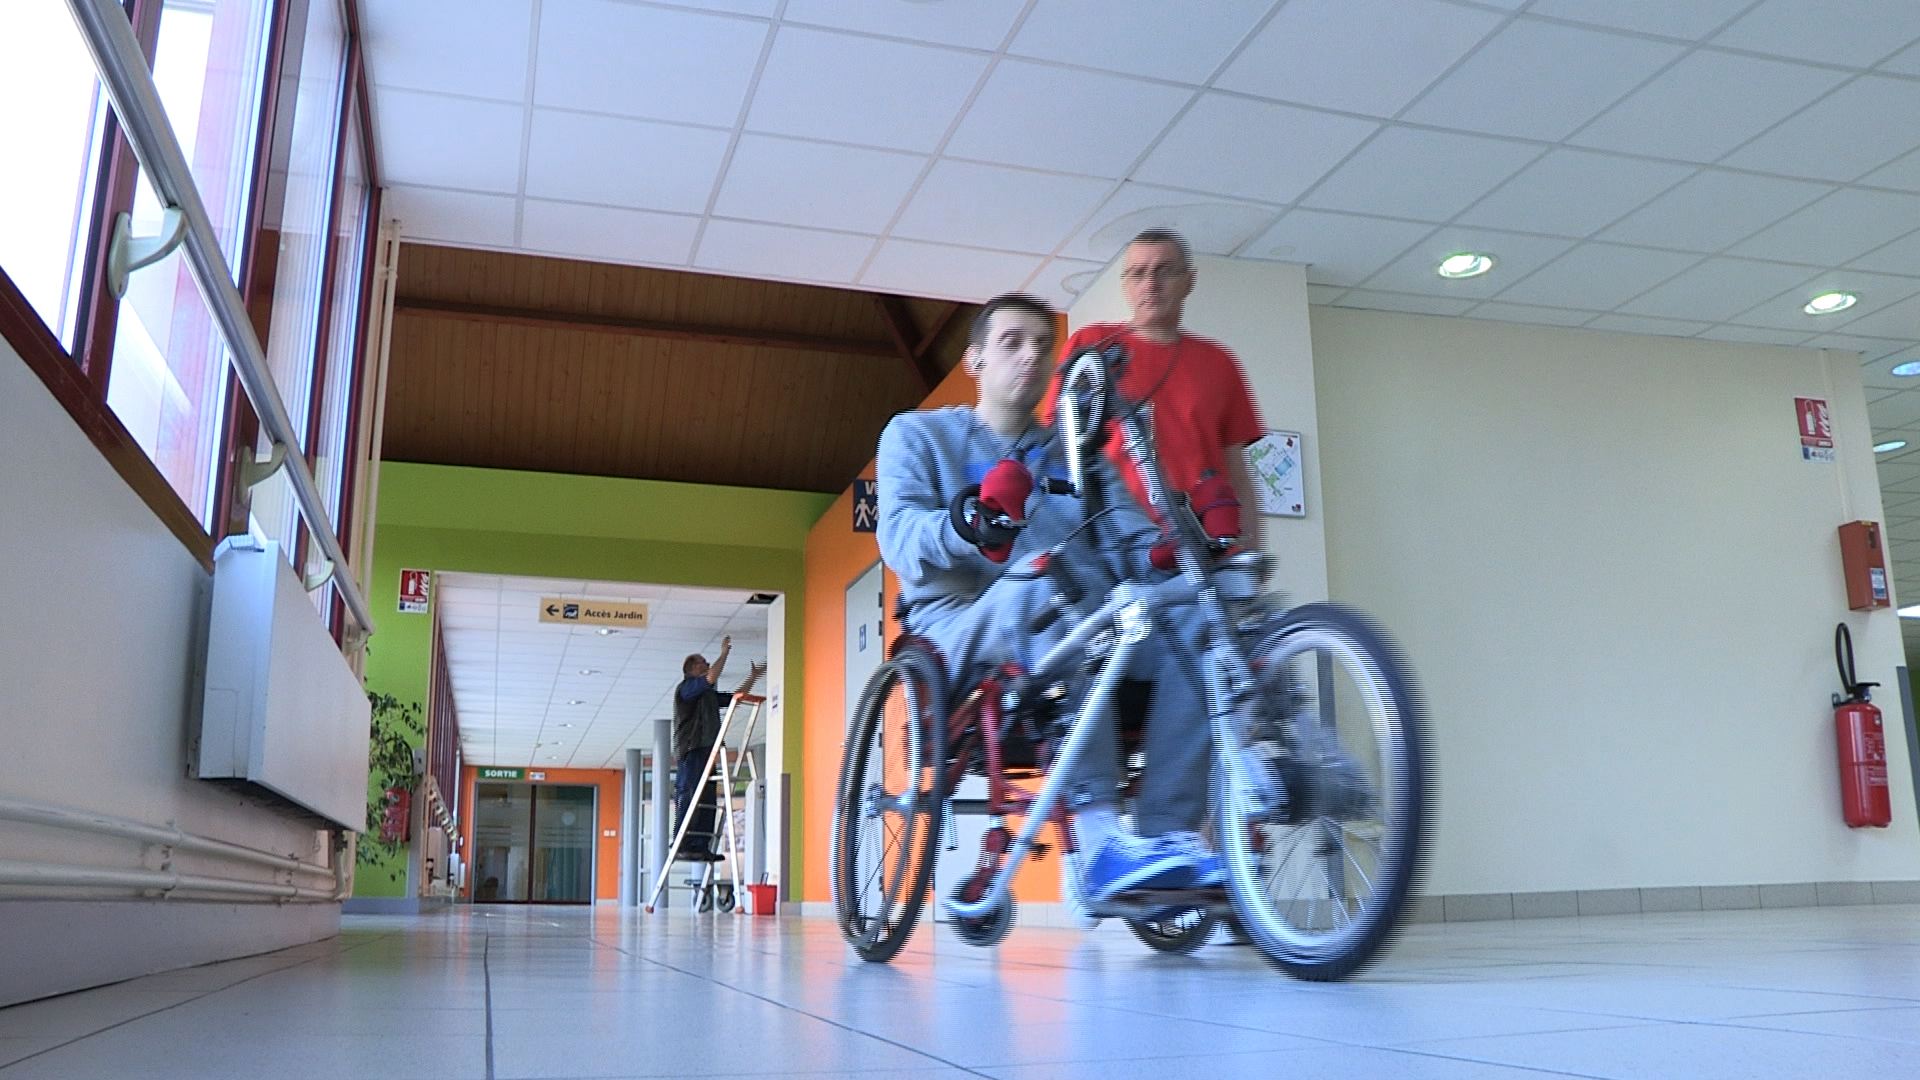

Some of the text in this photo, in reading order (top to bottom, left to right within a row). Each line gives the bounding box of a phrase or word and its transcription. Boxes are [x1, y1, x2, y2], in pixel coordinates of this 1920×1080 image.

[584, 608, 643, 620] Accès Jardin
[484, 769, 518, 778] SORTIE
